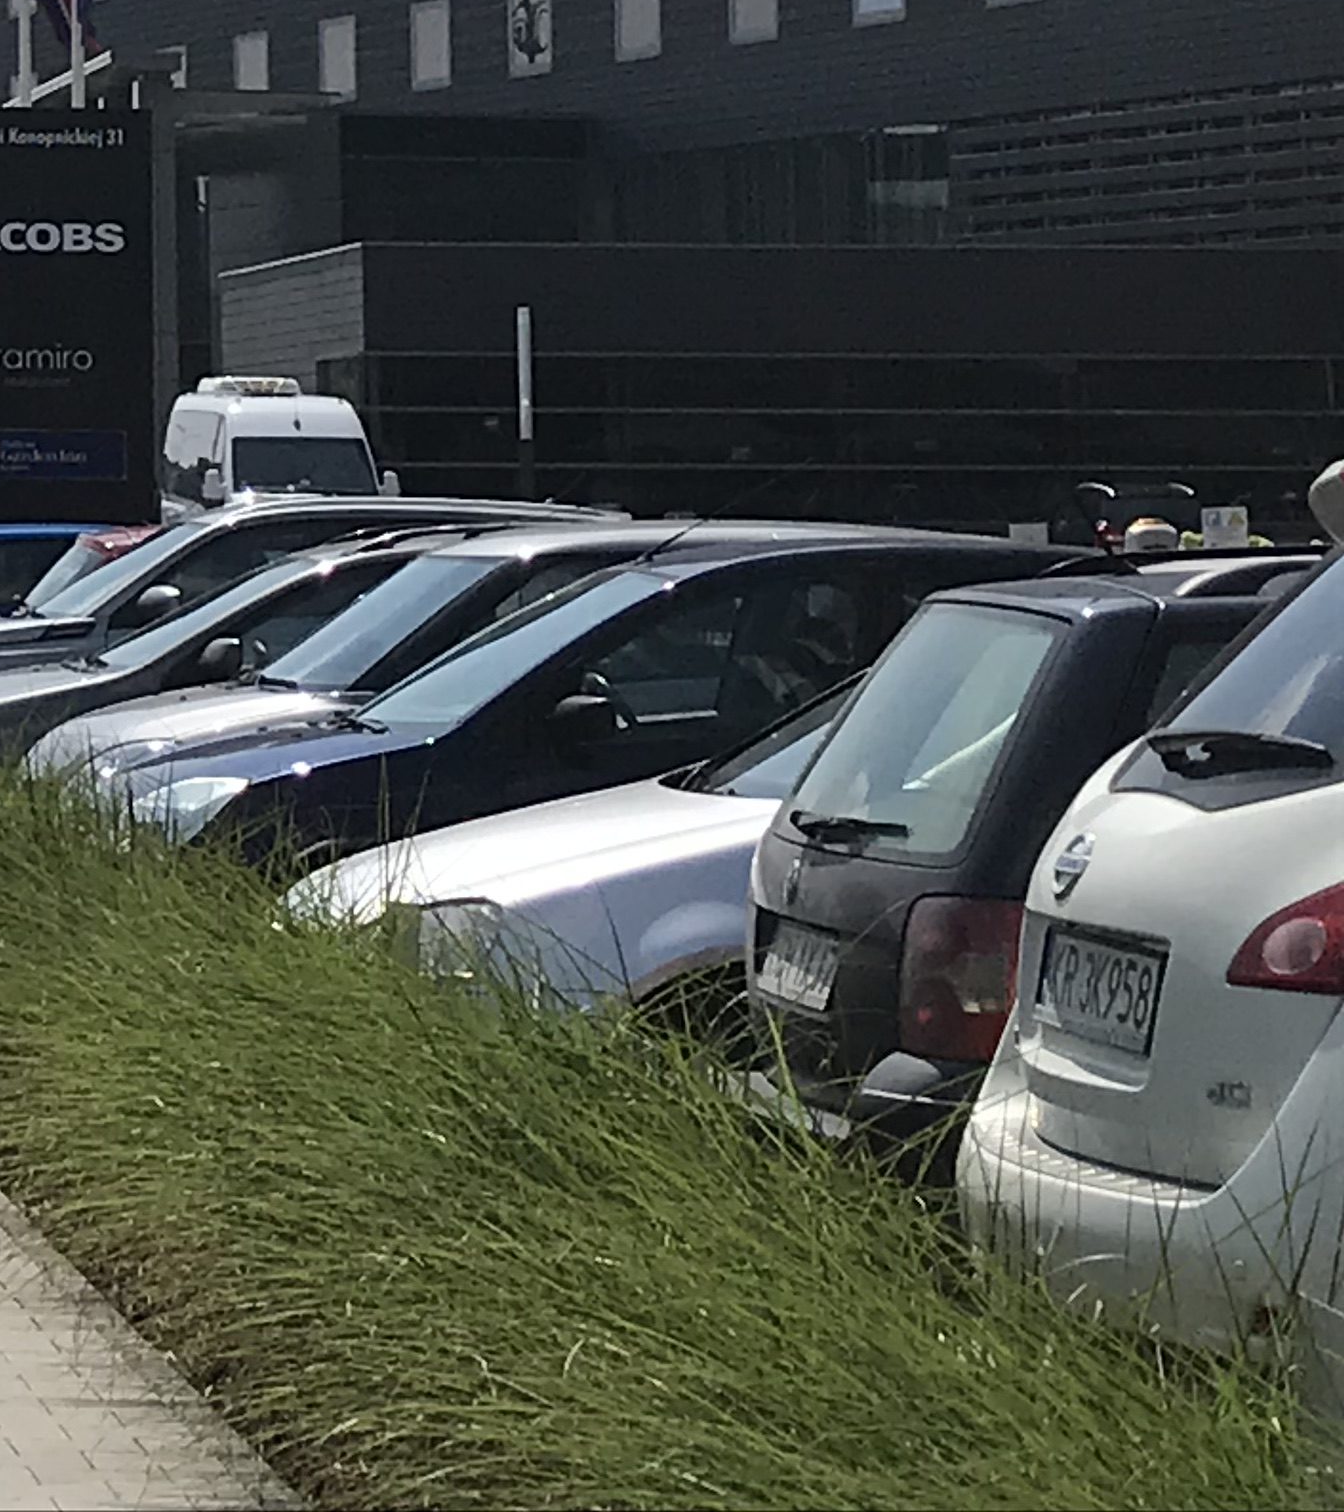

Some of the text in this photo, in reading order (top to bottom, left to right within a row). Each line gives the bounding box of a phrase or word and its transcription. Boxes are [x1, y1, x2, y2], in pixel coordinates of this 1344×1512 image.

[8, 127, 102, 148] Konopnickiej
[106, 128, 124, 145] 31
[1051, 944, 1079, 1008] KR
